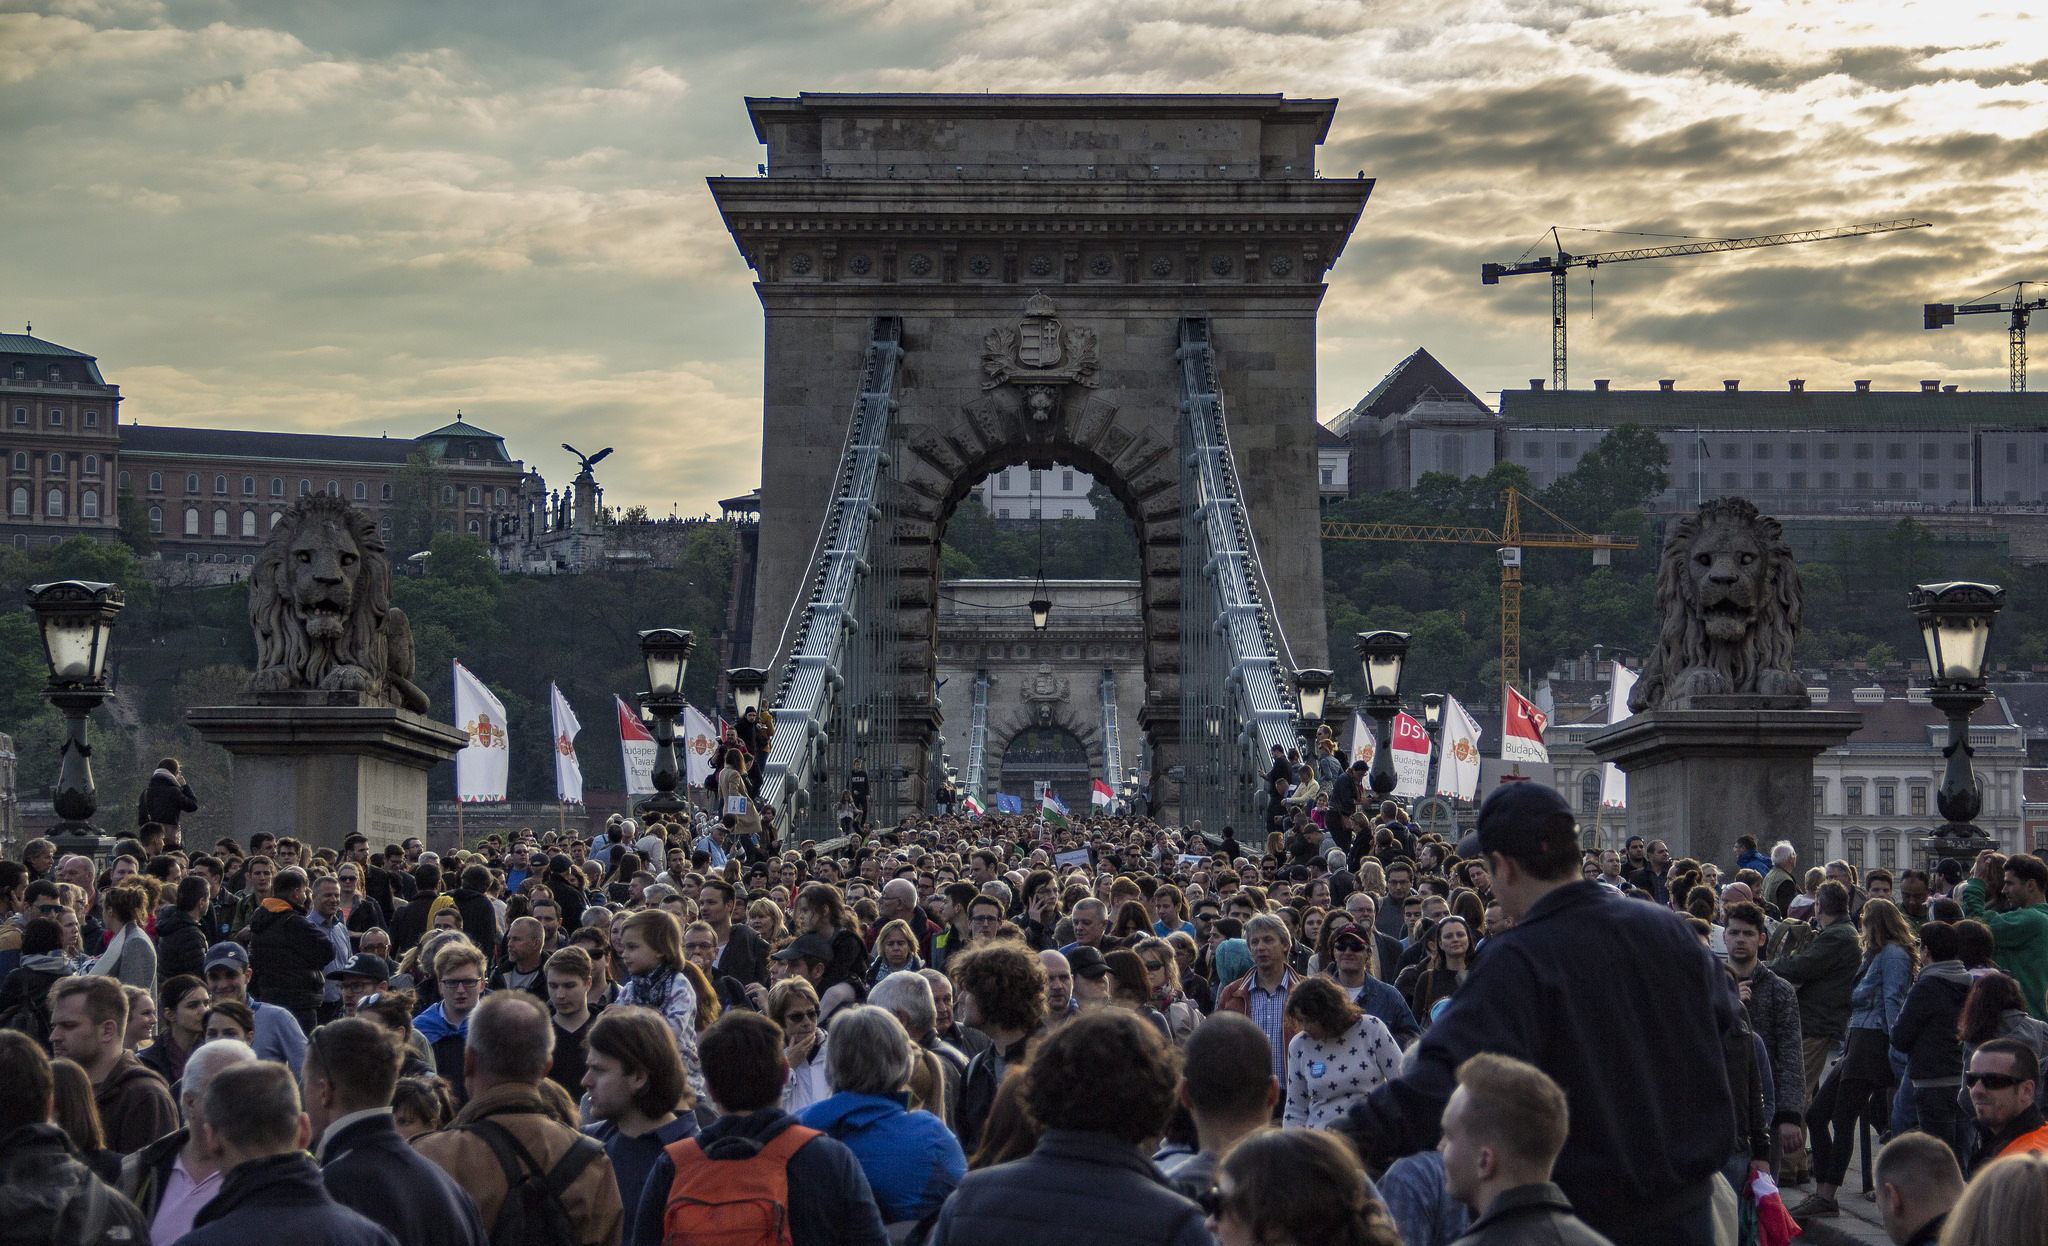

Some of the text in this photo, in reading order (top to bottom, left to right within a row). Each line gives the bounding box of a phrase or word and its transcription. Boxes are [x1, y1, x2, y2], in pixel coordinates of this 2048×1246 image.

[1394, 754, 1427, 767] Budapest
[631, 767, 651, 776] Feszti
[1403, 766, 1426, 778] Spring
[1398, 775, 1425, 785] Festival
[345, 955, 359, 969] S
